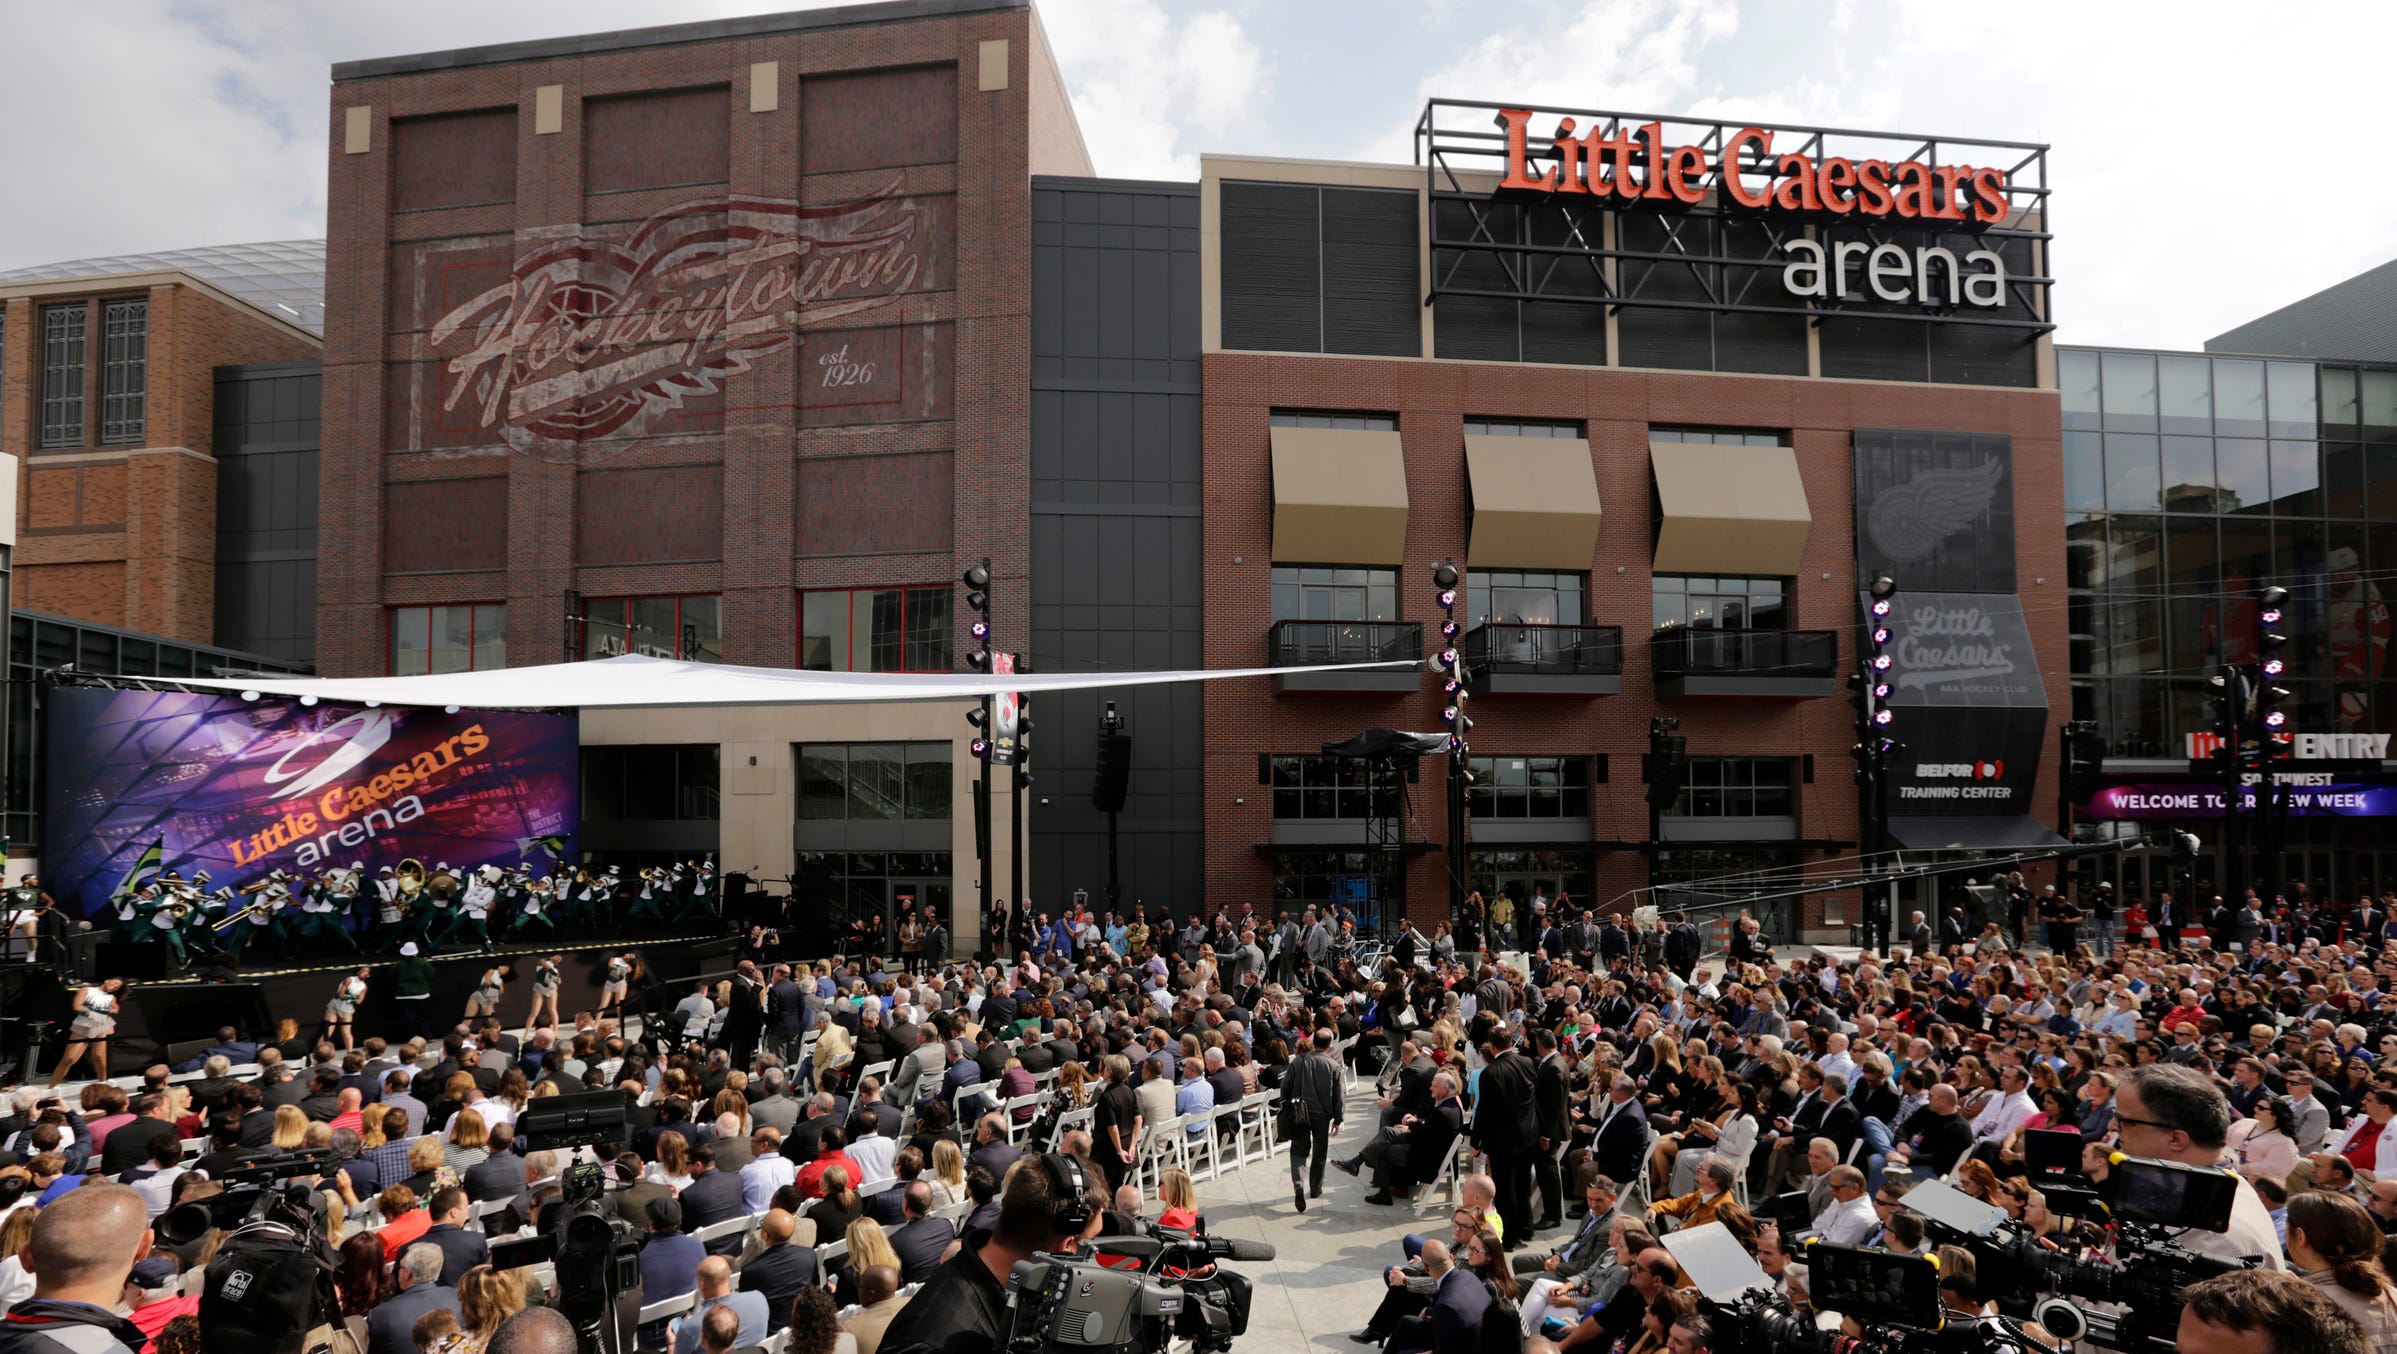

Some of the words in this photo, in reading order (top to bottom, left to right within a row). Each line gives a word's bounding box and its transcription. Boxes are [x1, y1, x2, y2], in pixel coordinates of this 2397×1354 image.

[1495, 108, 1706, 203] Little
[1721, 126, 2009, 224] Caesars
[1783, 237, 2007, 307] arena
[431, 233, 919, 428] Hockeytown
[819, 344, 848, 365] est.
[822, 361, 875, 387] 1926
[1908, 606, 1995, 637] Little
[1898, 635, 2011, 669] Caesars
[2003, 685, 2029, 693] CLUB
[2294, 733, 2392, 759] ENTRY
[1916, 763, 1974, 778] BELFOR
[2241, 773, 2334, 787] SOTHWEST
[227, 811, 318, 868] Little
[320, 723, 490, 821] Caesars
[1900, 786, 1960, 799] TRAINING
[1961, 786, 2012, 799] CENTER
[2112, 795, 2199, 809] WELCOME
[2317, 793, 2367, 808] WEEK
[528, 808, 542, 821] THE
[531, 811, 562, 831] DISTRICT
[294, 794, 425, 866] arena
